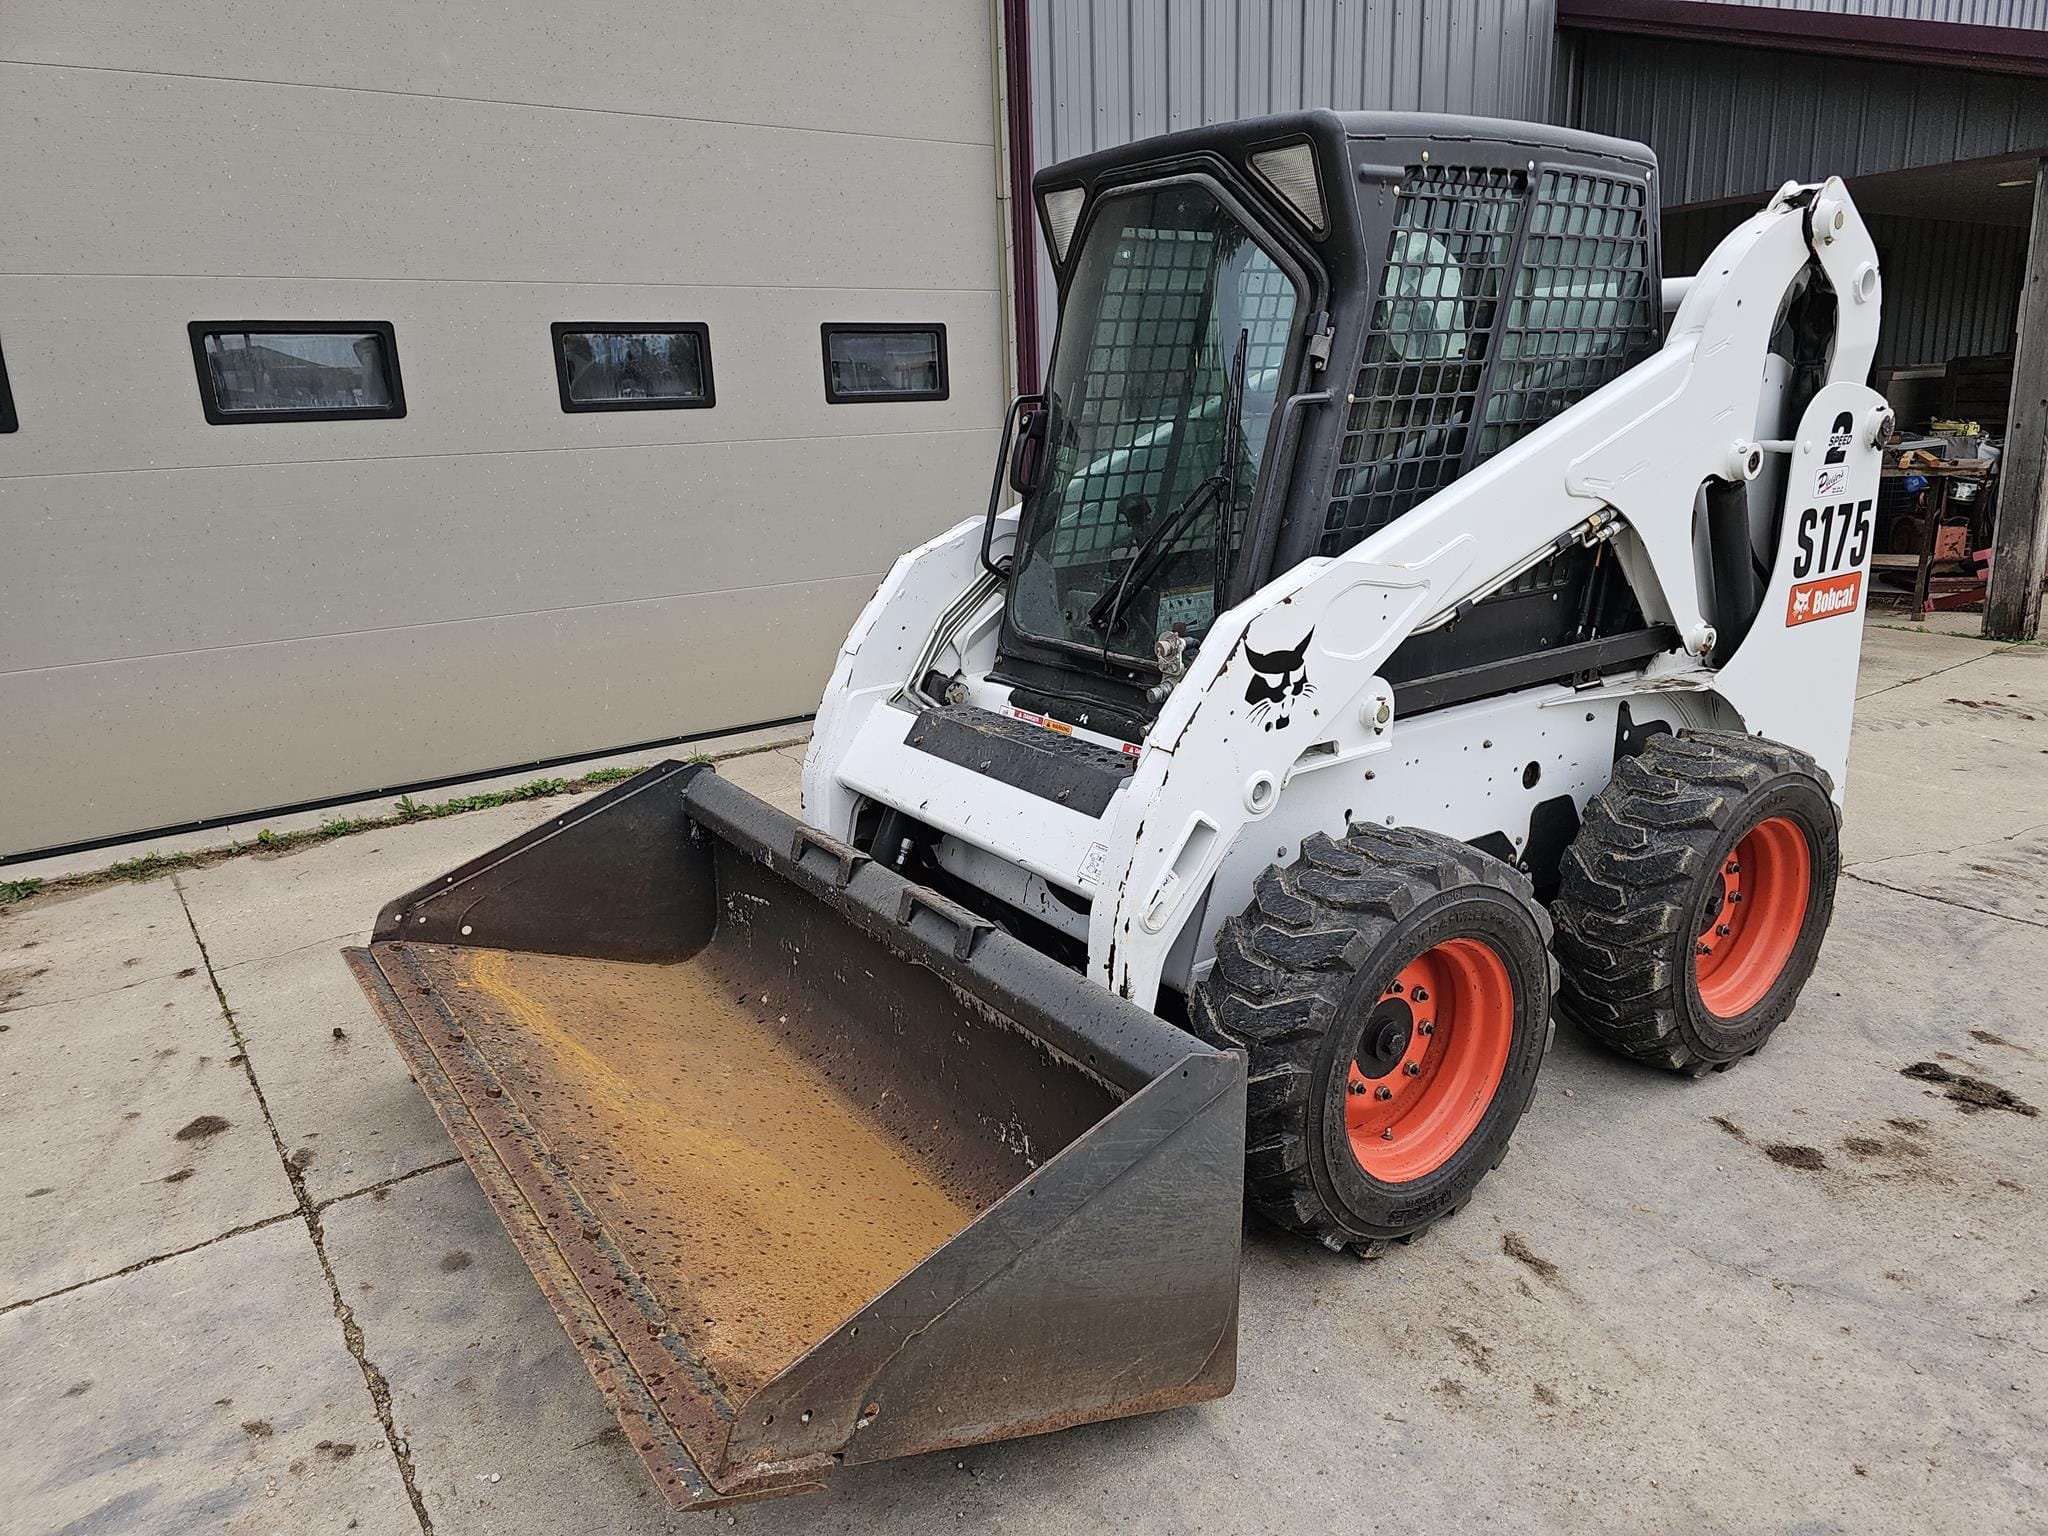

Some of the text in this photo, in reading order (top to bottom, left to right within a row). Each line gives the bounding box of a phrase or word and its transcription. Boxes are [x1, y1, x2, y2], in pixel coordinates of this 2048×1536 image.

[1824, 411, 1853, 464] 2
[1828, 434, 1853, 448] SPEED
[1793, 499, 1872, 578] S175
[1812, 584, 1855, 614] Bobcat
[1023, 713, 1040, 723] DANGER
